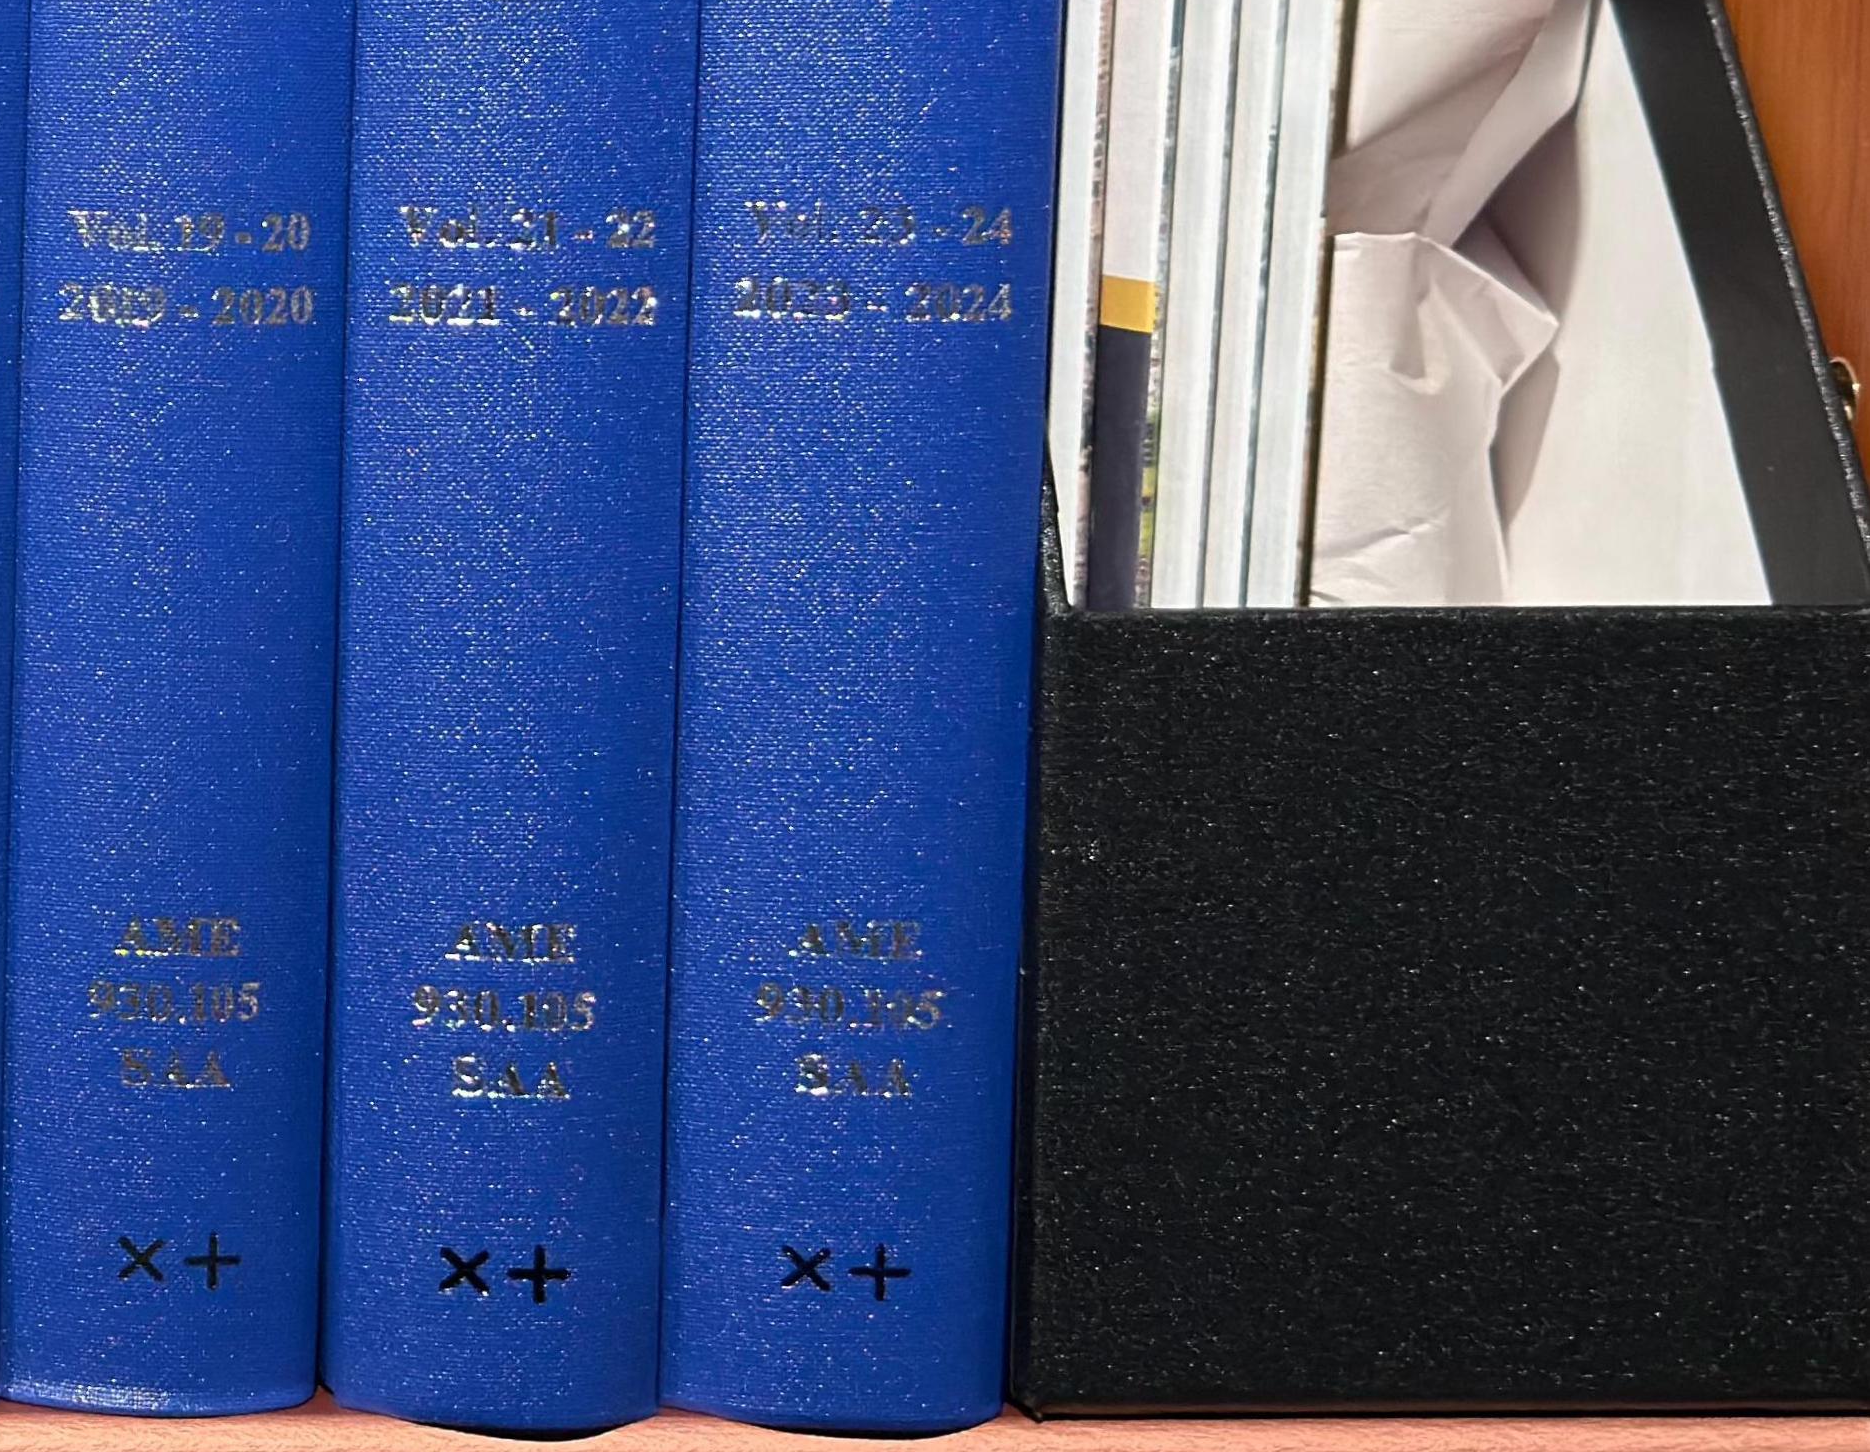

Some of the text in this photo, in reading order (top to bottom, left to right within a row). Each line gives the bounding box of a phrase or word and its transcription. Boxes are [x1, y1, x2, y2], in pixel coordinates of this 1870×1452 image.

[173, 212, 225, 253] 19
[261, 212, 312, 252] 20
[606, 207, 656, 248] 22
[960, 206, 1013, 246] 24
[212, 286, 316, 327] 2020
[388, 280, 500, 327] 2021
[549, 282, 657, 326] 2022
[906, 282, 1013, 324] 2024
[114, 917, 242, 957] AME
[445, 921, 577, 964] AME
[89, 981, 260, 1024] 930.105
[411, 984, 597, 1032] 930.105
[121, 1047, 231, 1089] SAA
[451, 1053, 571, 1099] SAA
